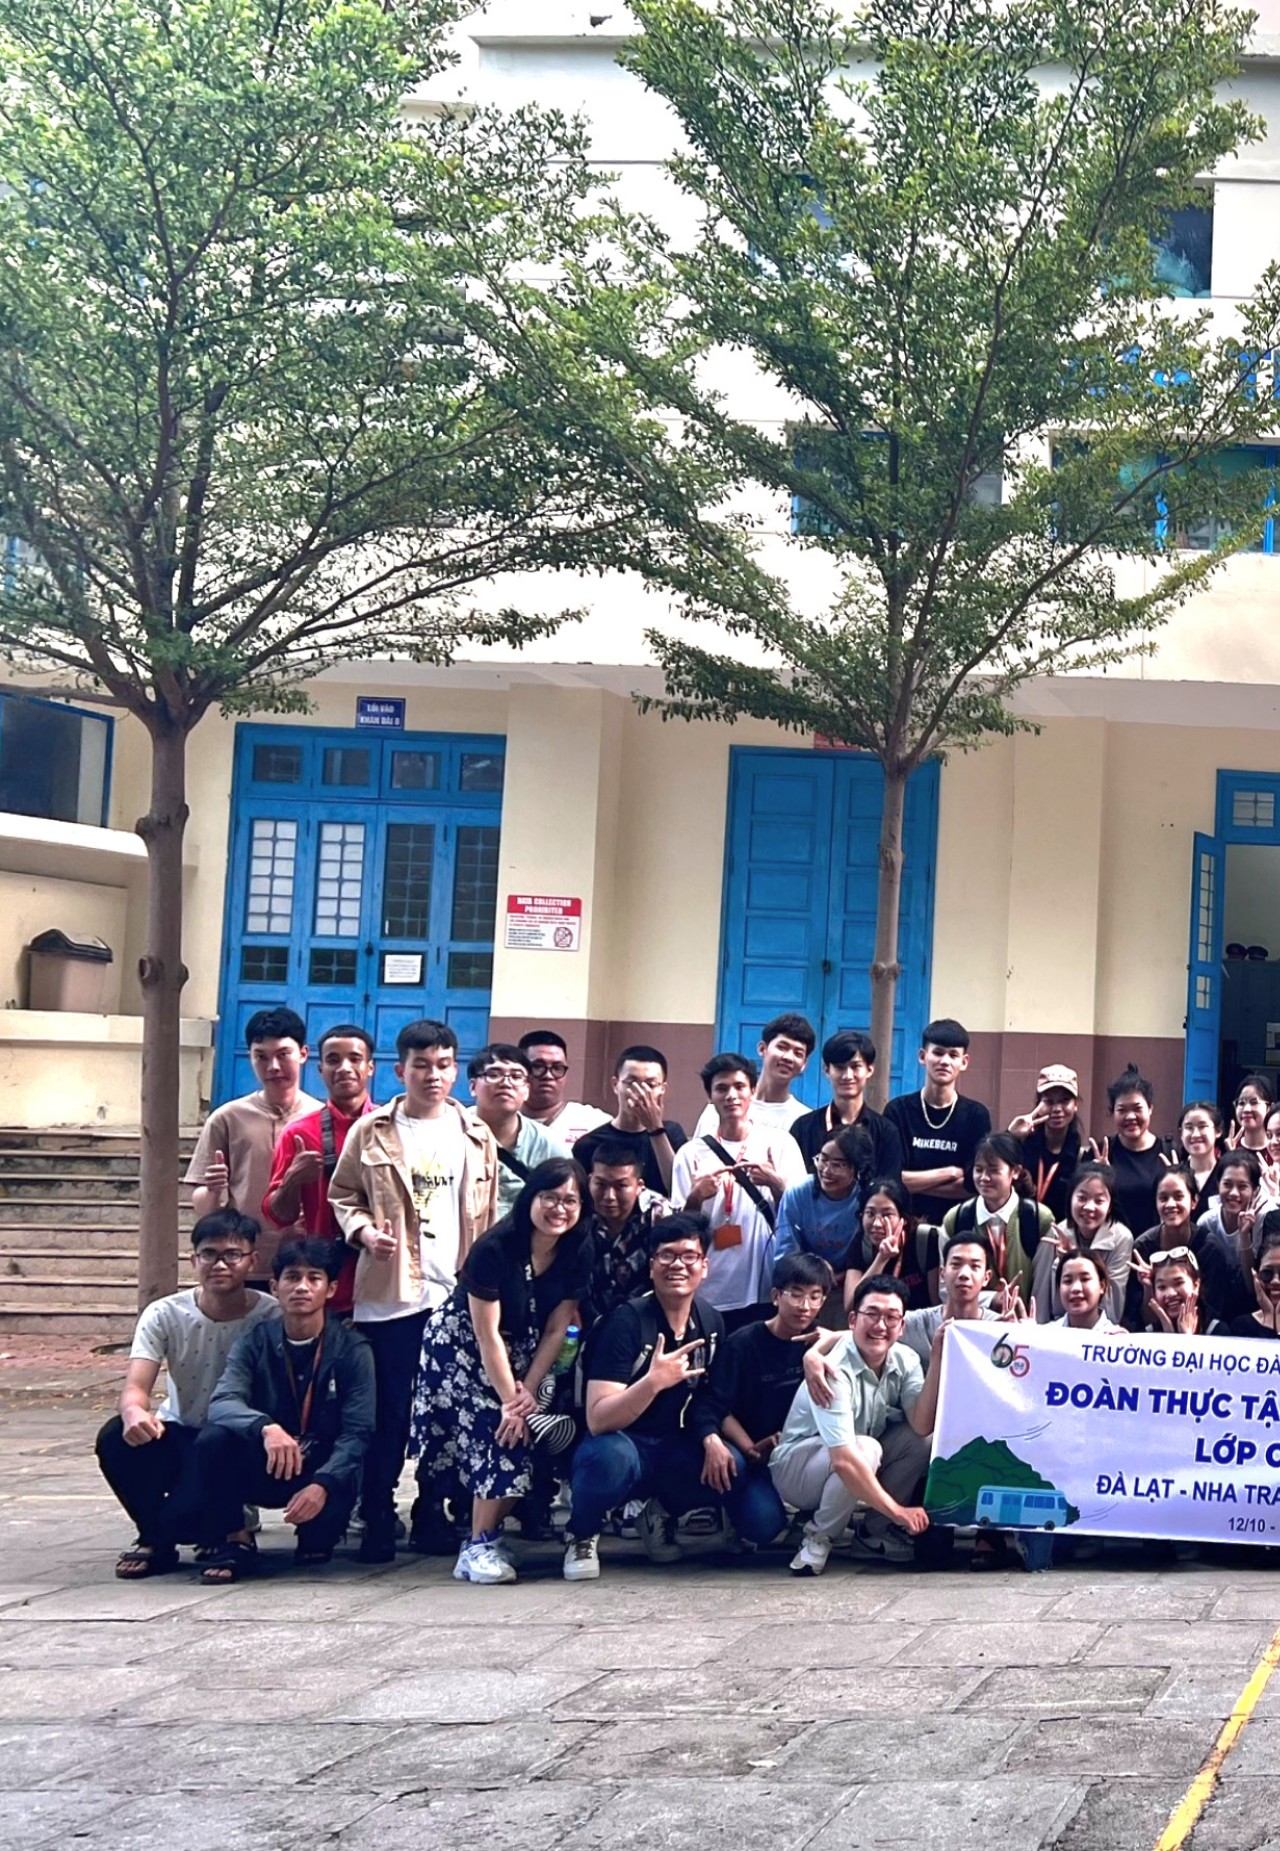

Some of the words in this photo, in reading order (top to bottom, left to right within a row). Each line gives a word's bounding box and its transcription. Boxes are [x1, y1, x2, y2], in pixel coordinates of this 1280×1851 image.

[1082, 1343, 1166, 1367] TRƯỜNG
[1171, 1351, 1204, 1373] ĐẠI
[1209, 1353, 1251, 1376] HỌC
[1045, 1378, 1139, 1412] ĐOÀN
[1148, 1387, 1233, 1424] THỰC
[1195, 1432, 1257, 1465] LỚP
[1096, 1471, 1127, 1496] ĐÀ
[1133, 1476, 1175, 1503] LẠT
[1192, 1480, 1238, 1503] NHA
[1228, 1517, 1266, 1533] 12/10
